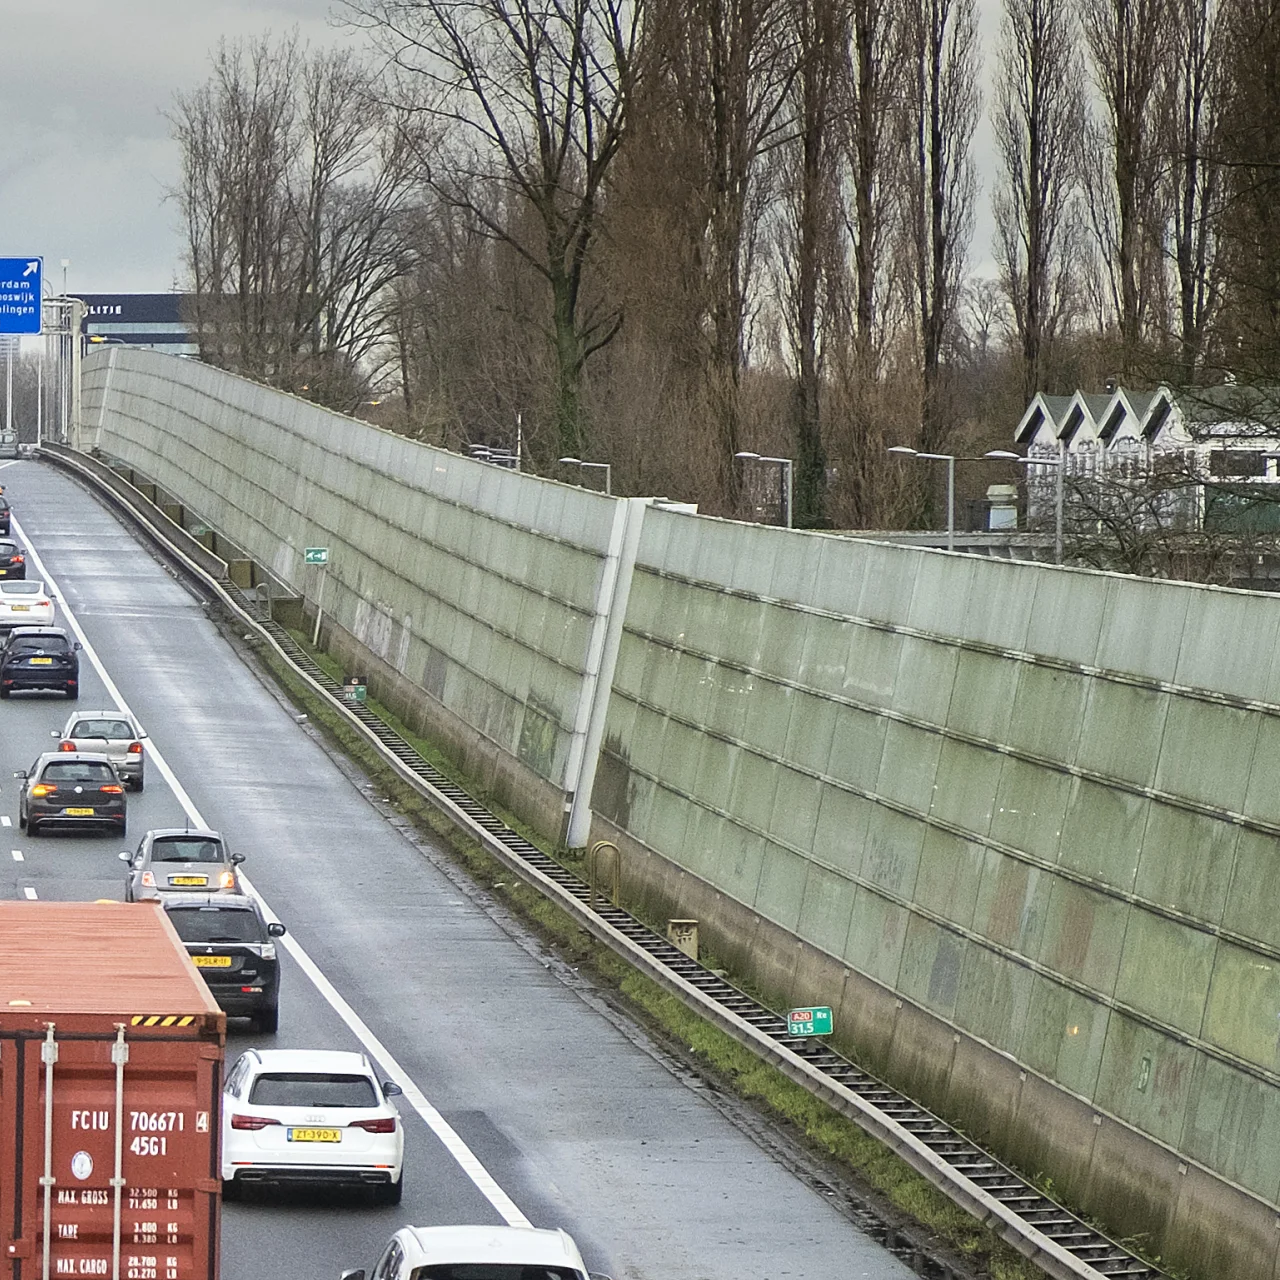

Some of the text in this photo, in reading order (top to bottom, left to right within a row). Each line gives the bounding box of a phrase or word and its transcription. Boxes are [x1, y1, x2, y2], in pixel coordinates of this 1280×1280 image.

[793, 1012, 810, 1020] A20
[72, 1111, 208, 1131] FCIU 706671 4
[130, 1136, 167, 1156] 45G1
[58, 1190, 79, 1204] MAX.
[81, 1190, 108, 1205] GROSS
[167, 1188, 178, 1197] KG
[167, 1199, 178, 1209] LB
[58, 1224, 78, 1239] TARE
[167, 1222, 178, 1233] KG
[167, 1235, 177, 1244] LB
[57, 1259, 77, 1274] MAX.
[80, 1259, 107, 1275] CARGO
[166, 1256, 177, 1267] KG
[166, 1269, 177, 1279] LB
